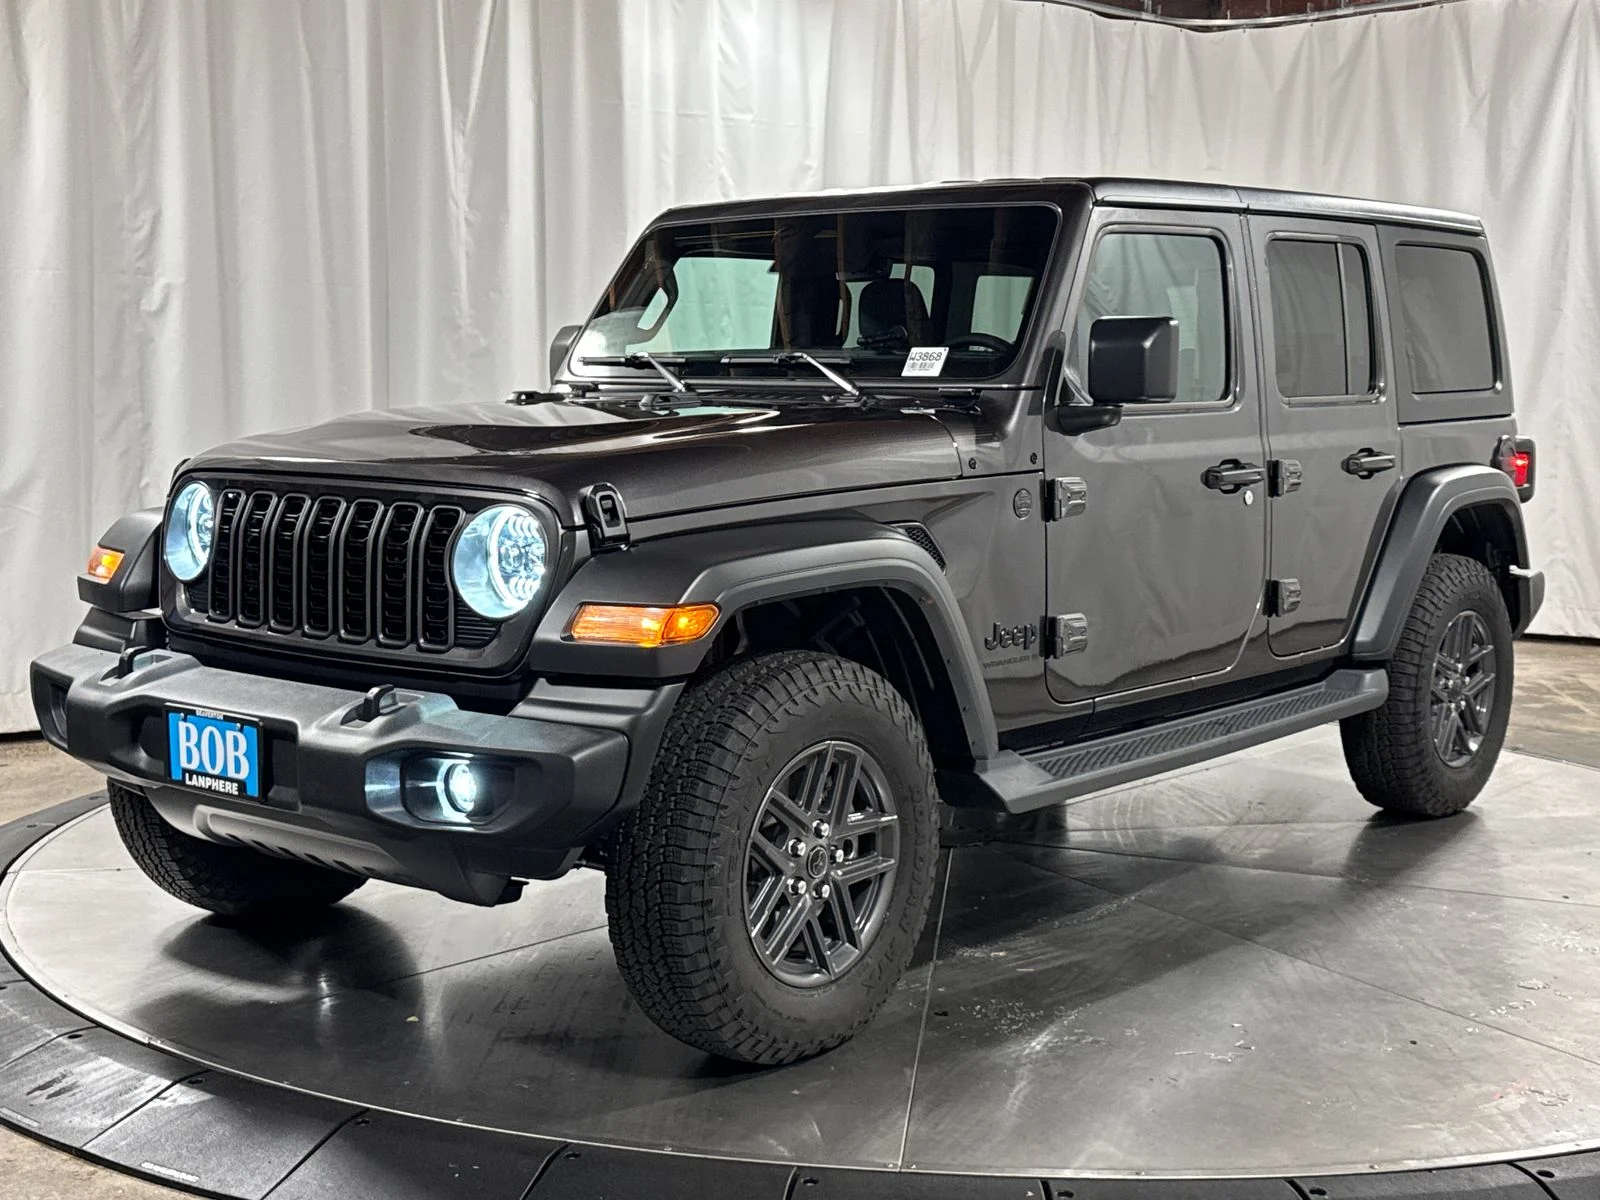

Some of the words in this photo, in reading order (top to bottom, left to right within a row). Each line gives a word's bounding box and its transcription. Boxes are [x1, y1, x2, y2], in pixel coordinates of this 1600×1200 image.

[909, 351, 943, 362] W3868
[984, 622, 1037, 651] Jeep
[178, 721, 249, 780] BOB
[185, 772, 239, 796] LANPHERE
